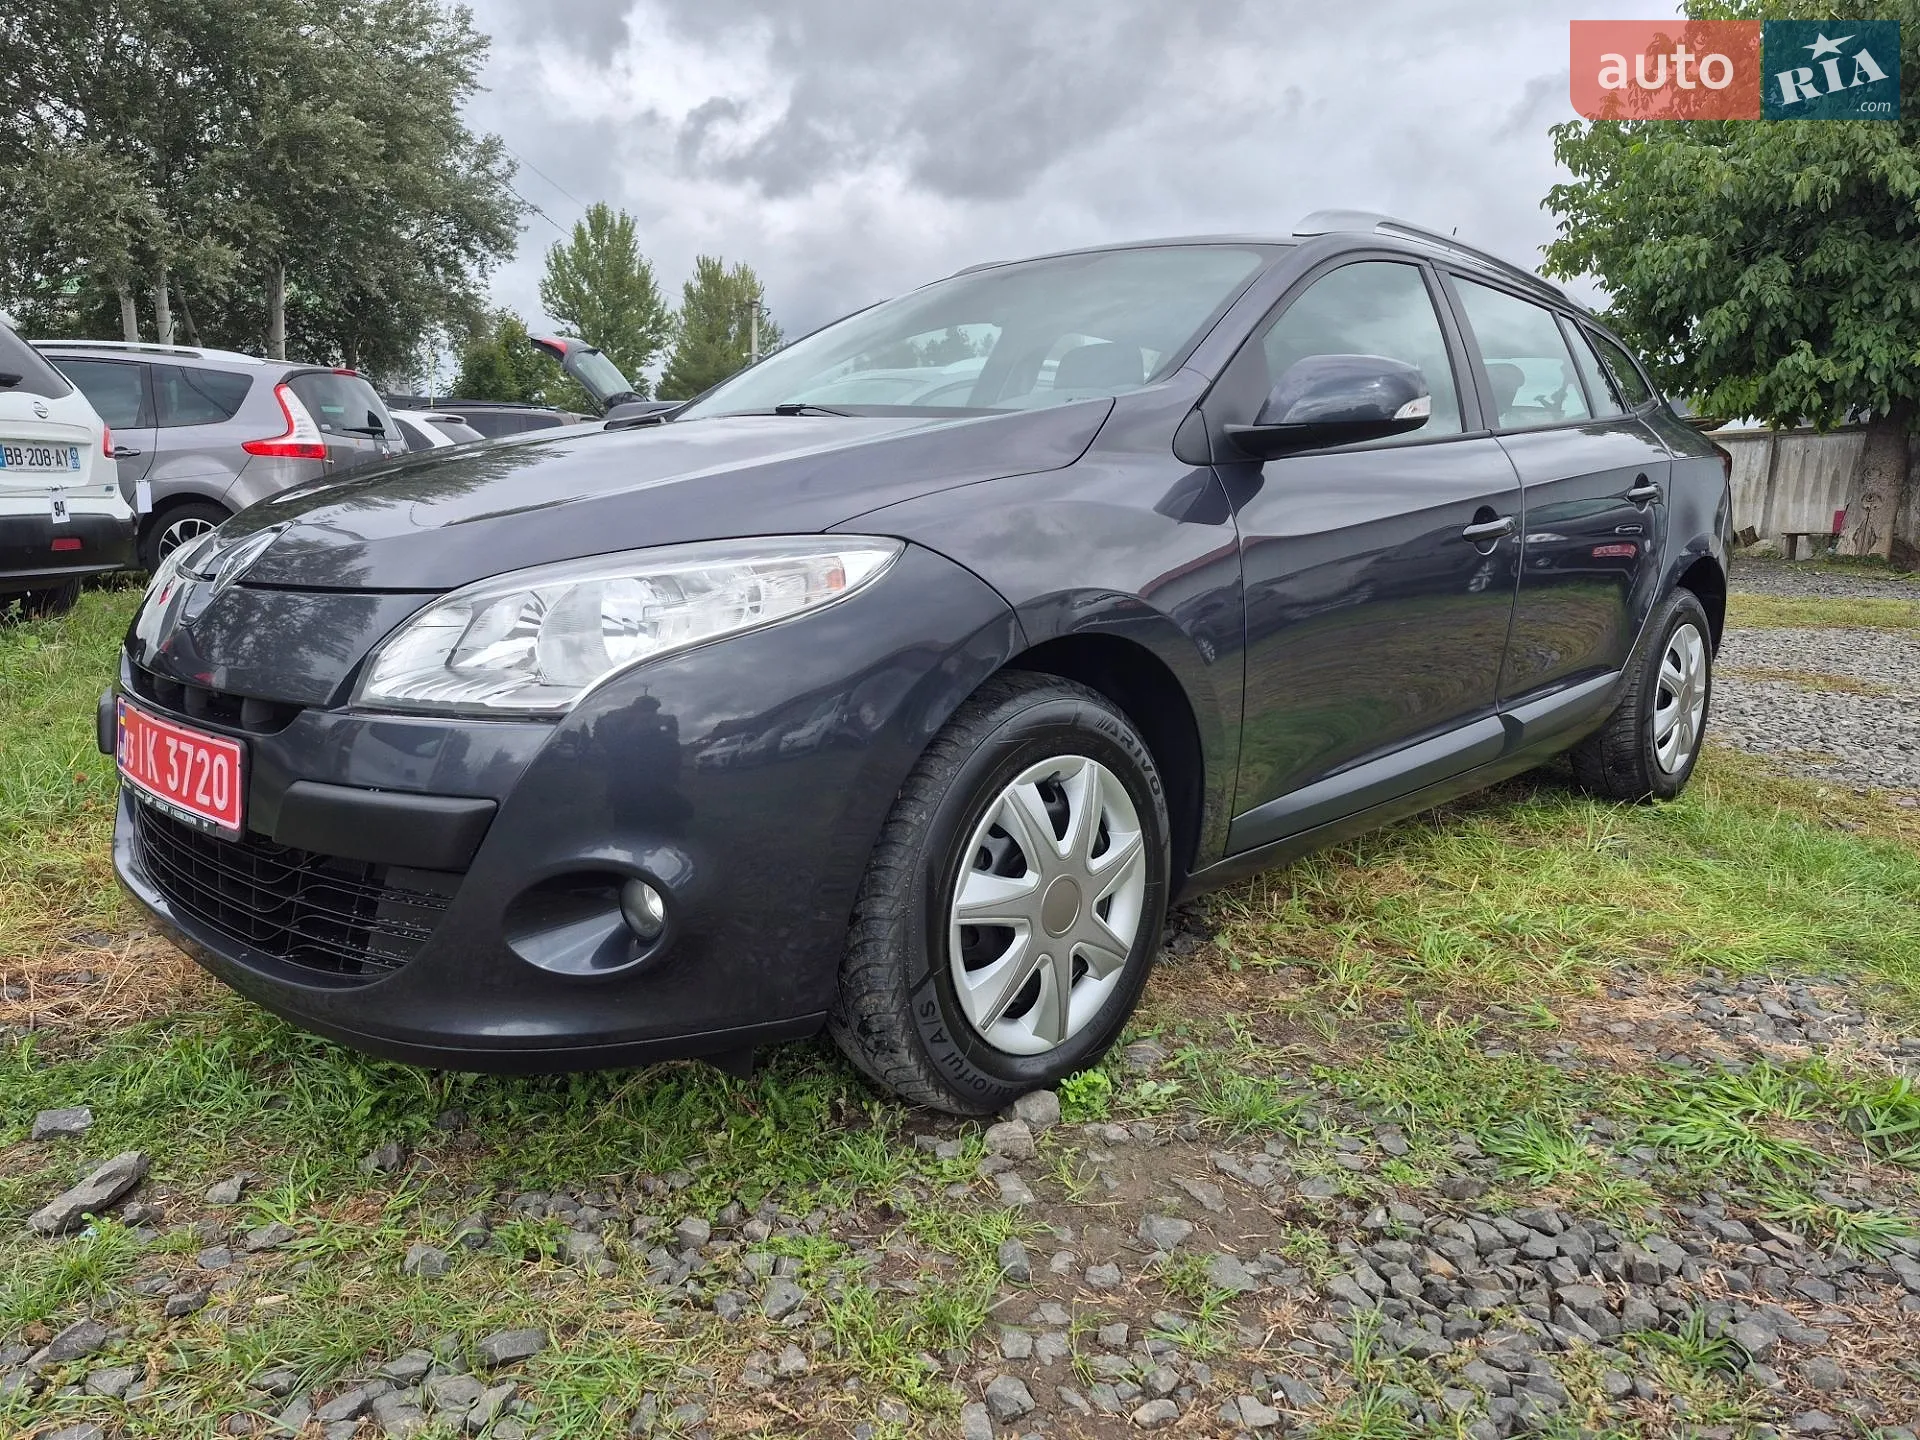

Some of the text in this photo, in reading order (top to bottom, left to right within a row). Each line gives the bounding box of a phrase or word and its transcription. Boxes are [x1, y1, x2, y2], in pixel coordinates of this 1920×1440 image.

[4, 447, 69, 467] BB-208-AY
[54, 501, 66, 517] 94
[166, 736, 229, 811] 3720
[1096, 717, 1160, 796] ARIVO
[919, 999, 948, 1045] A/S
